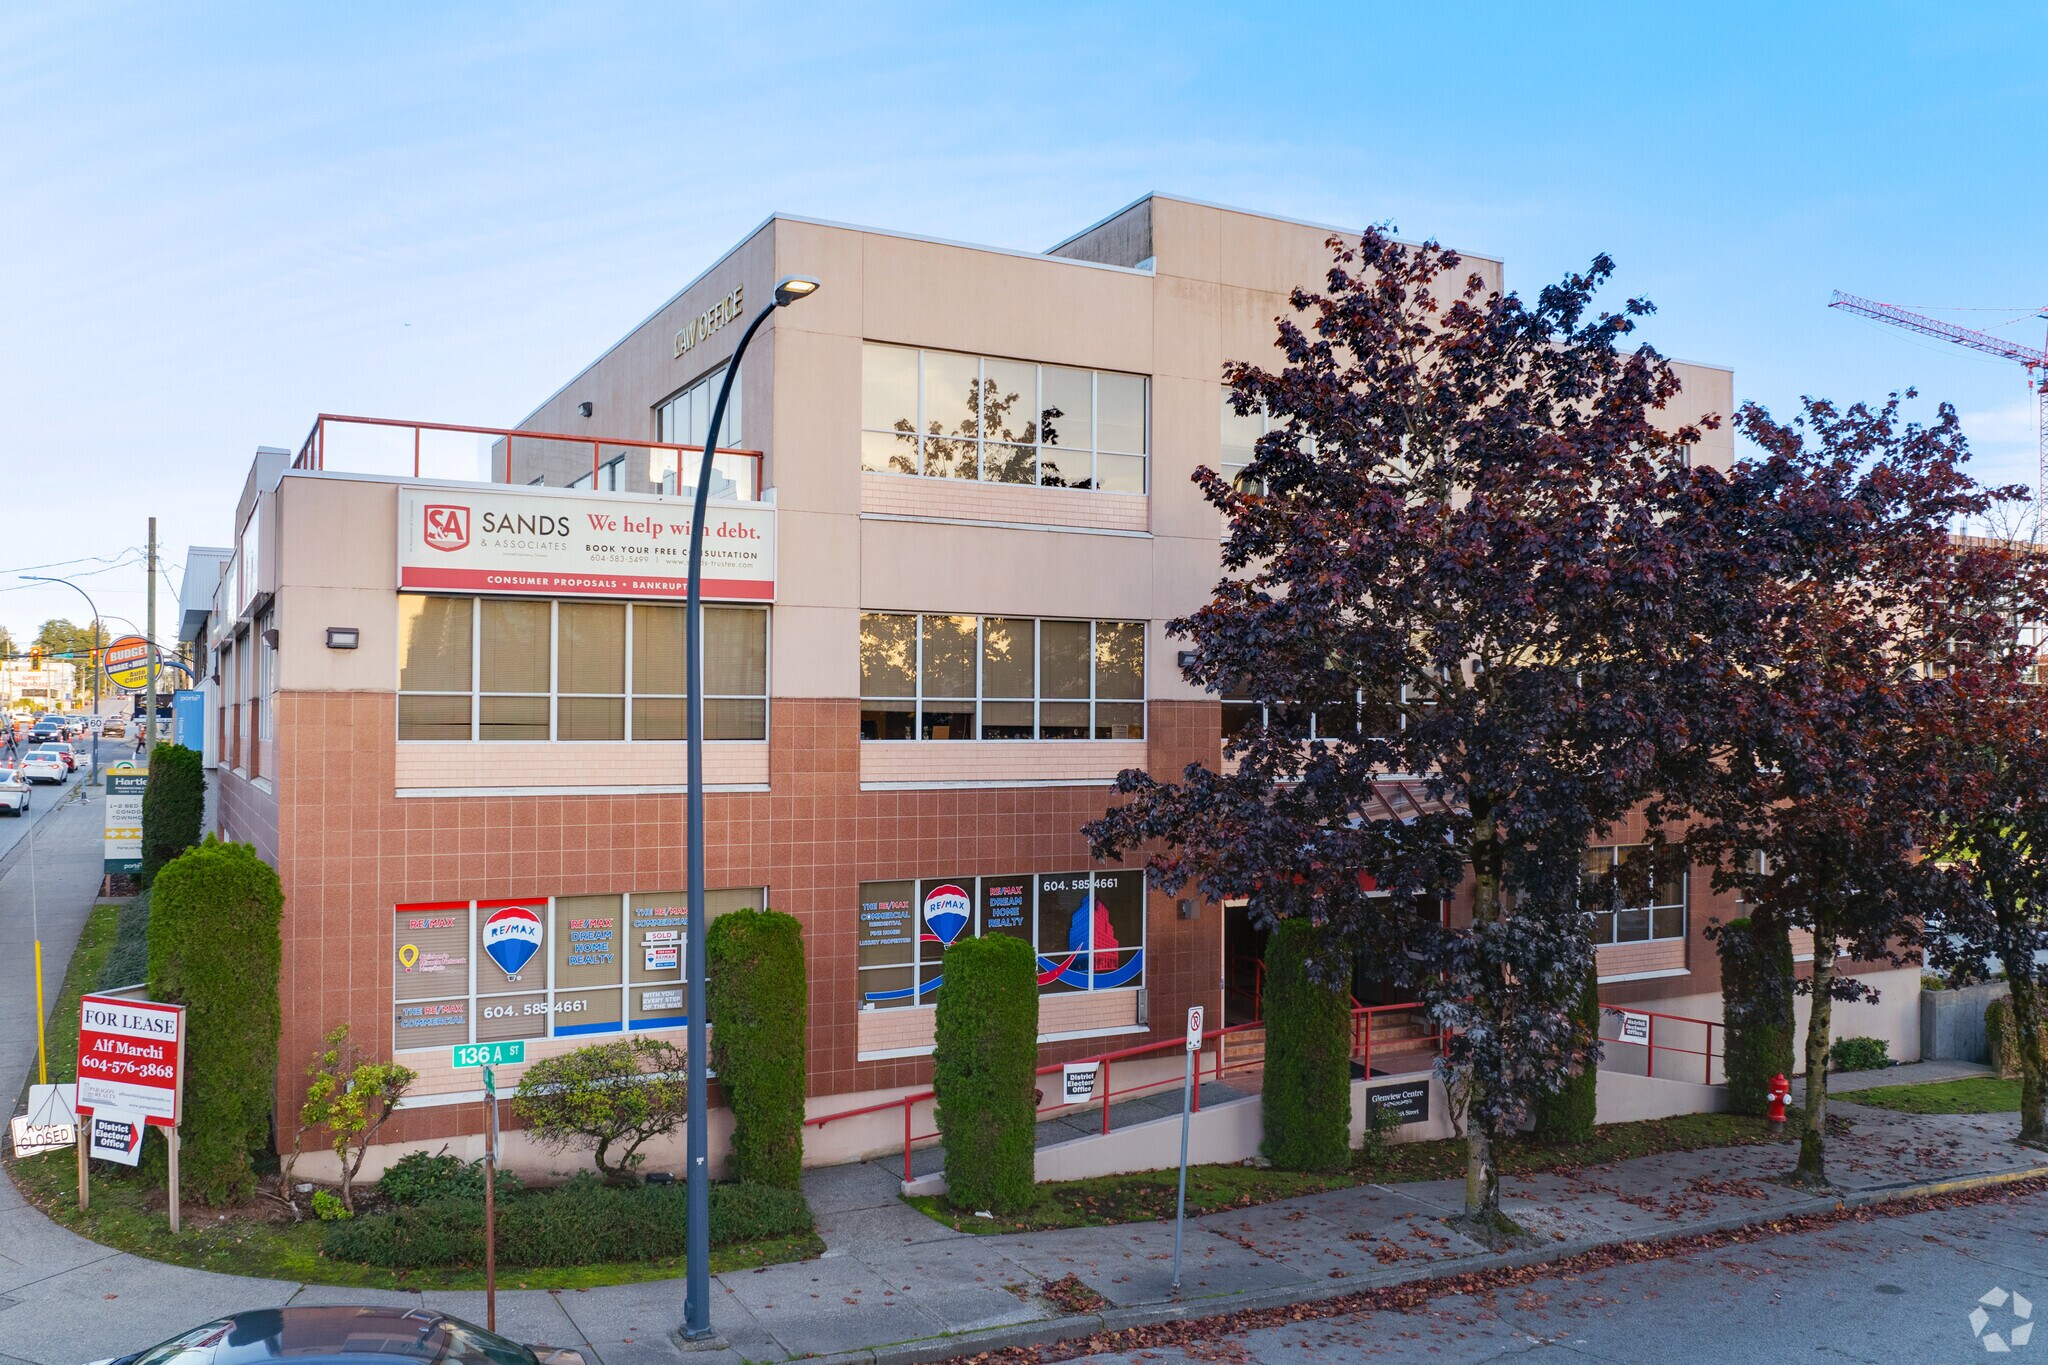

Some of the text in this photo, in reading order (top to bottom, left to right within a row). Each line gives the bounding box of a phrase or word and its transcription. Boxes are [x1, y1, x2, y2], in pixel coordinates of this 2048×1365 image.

[699, 284, 743, 341] OFFICE
[482, 512, 570, 537] SANDS
[587, 513, 617, 532] We
[623, 515, 663, 540] help
[716, 521, 761, 540] debt.
[494, 540, 567, 551] ASSOCIATES
[585, 544, 758, 560] BOOK YOUR FREE CSULTATION
[590, 554, 649, 563] 604-583-5499
[487, 575, 688, 591] CONSUMER PROPOSALS BANKRUPT
[129, 670, 146, 678] Auto
[90, 719, 102, 728] 60
[115, 778, 148, 786] Hartle
[1071, 880, 1090, 890] 585
[1094, 878, 1119, 889] 4661
[989, 886, 1023, 896] RE/MAX
[862, 900, 909, 911] THE RE/MAX
[930, 900, 965, 912] RE/MAX
[989, 897, 1023, 907] DREAM
[635, 908, 653, 917] THE
[860, 910, 911, 921] COMMERCIAL
[992, 907, 1020, 917] HOME
[409, 918, 455, 930] RE/MAX
[570, 918, 613, 929] RE/MAX
[988, 917, 1024, 928] REALTY
[491, 924, 536, 938] RE/MAX
[570, 930, 613, 942] DREAM
[574, 942, 609, 953] HOME
[568, 954, 614, 966] REALTY
[665, 995, 681, 1003] STEP
[403, 1004, 464, 1017] THE RE/MAX
[523, 1003, 548, 1016] 585
[554, 1000, 588, 1013] 4661
[84, 1009, 175, 1034] FOR LEASE
[400, 1016, 465, 1028] COMMERCIAL
[93, 1038, 163, 1060] Alf Marchi
[458, 1045, 520, 1065] 136 A ST
[81, 1054, 174, 1079] 604-576-3868
[1070, 1073, 1095, 1081] District
[1067, 1080, 1095, 1088] Electora
[1371, 1089, 1424, 1103] Glenview Centre
[98, 1121, 129, 1134] District
[20, 1128, 69, 1150] CLOSED
[95, 1129, 132, 1142] Electoral
[100, 1139, 125, 1149] Office
